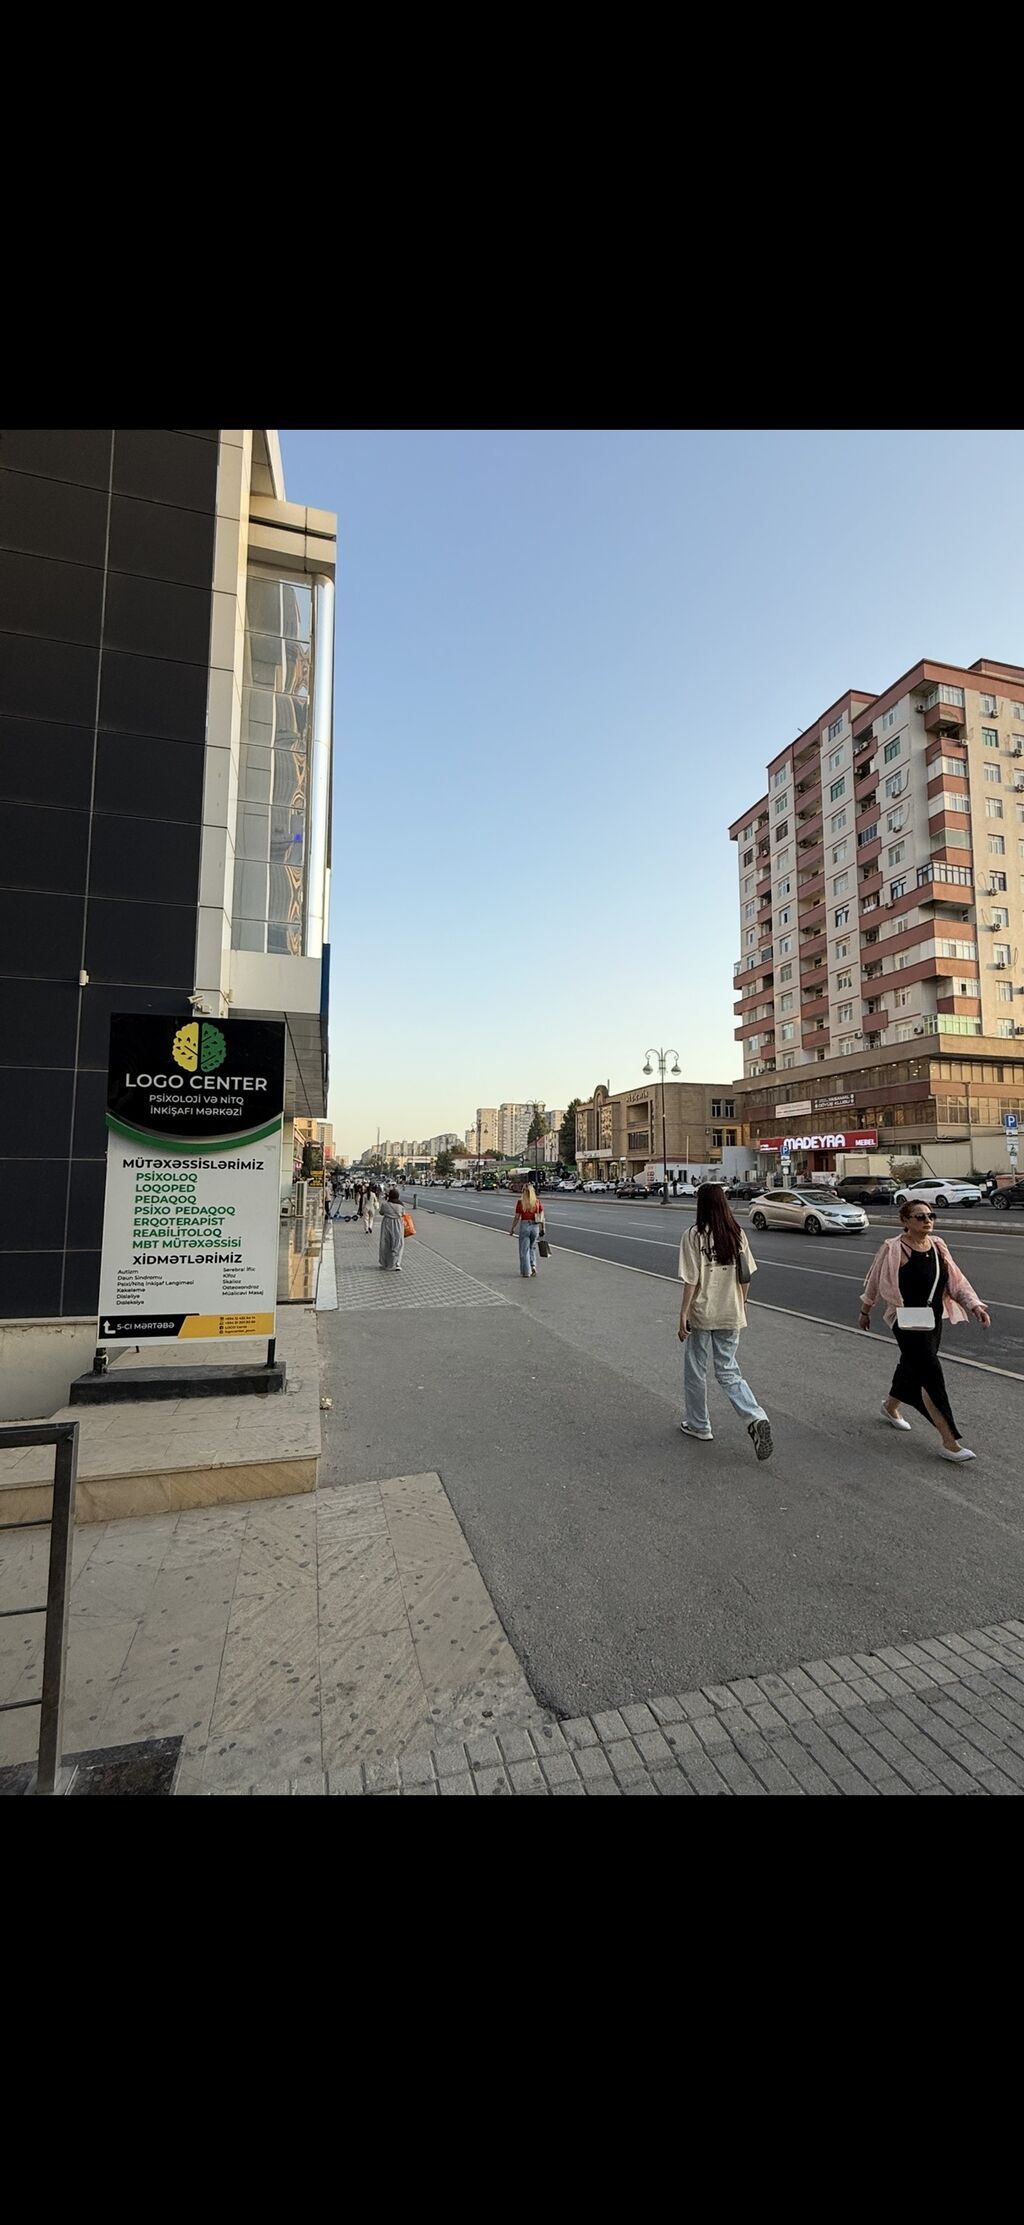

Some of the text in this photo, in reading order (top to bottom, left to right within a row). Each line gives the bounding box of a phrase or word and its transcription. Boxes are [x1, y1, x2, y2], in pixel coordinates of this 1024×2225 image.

[125, 1073, 268, 1091] LOGO CENTER
[149, 1093, 244, 1106] PSİXOLOJİ VƏ NİTQ
[150, 1105, 242, 1117] İNKİŞAFI MƏRKƏZİ
[1008, 1116, 1015, 1127] P
[783, 1134, 846, 1150] MADEYRA
[122, 1157, 264, 1170] MÜTƏXƏSSİSLƏRİMİZ
[136, 1170, 198, 1182] PSİXOLOQ
[135, 1184, 196, 1193] LOQOPED
[135, 1195, 197, 1205] PEDAQOQ
[134, 1204, 236, 1216] PSİXO PEDAQOQ
[133, 1215, 226, 1227] ERQOTERAPİST
[133, 1226, 222, 1238] REABİLİTOLOQ
[132, 1236, 242, 1249] MBT MÜTƏXƏSSİSİ
[132, 1252, 242, 1265] XİDMƏTLƏRİMİZ
